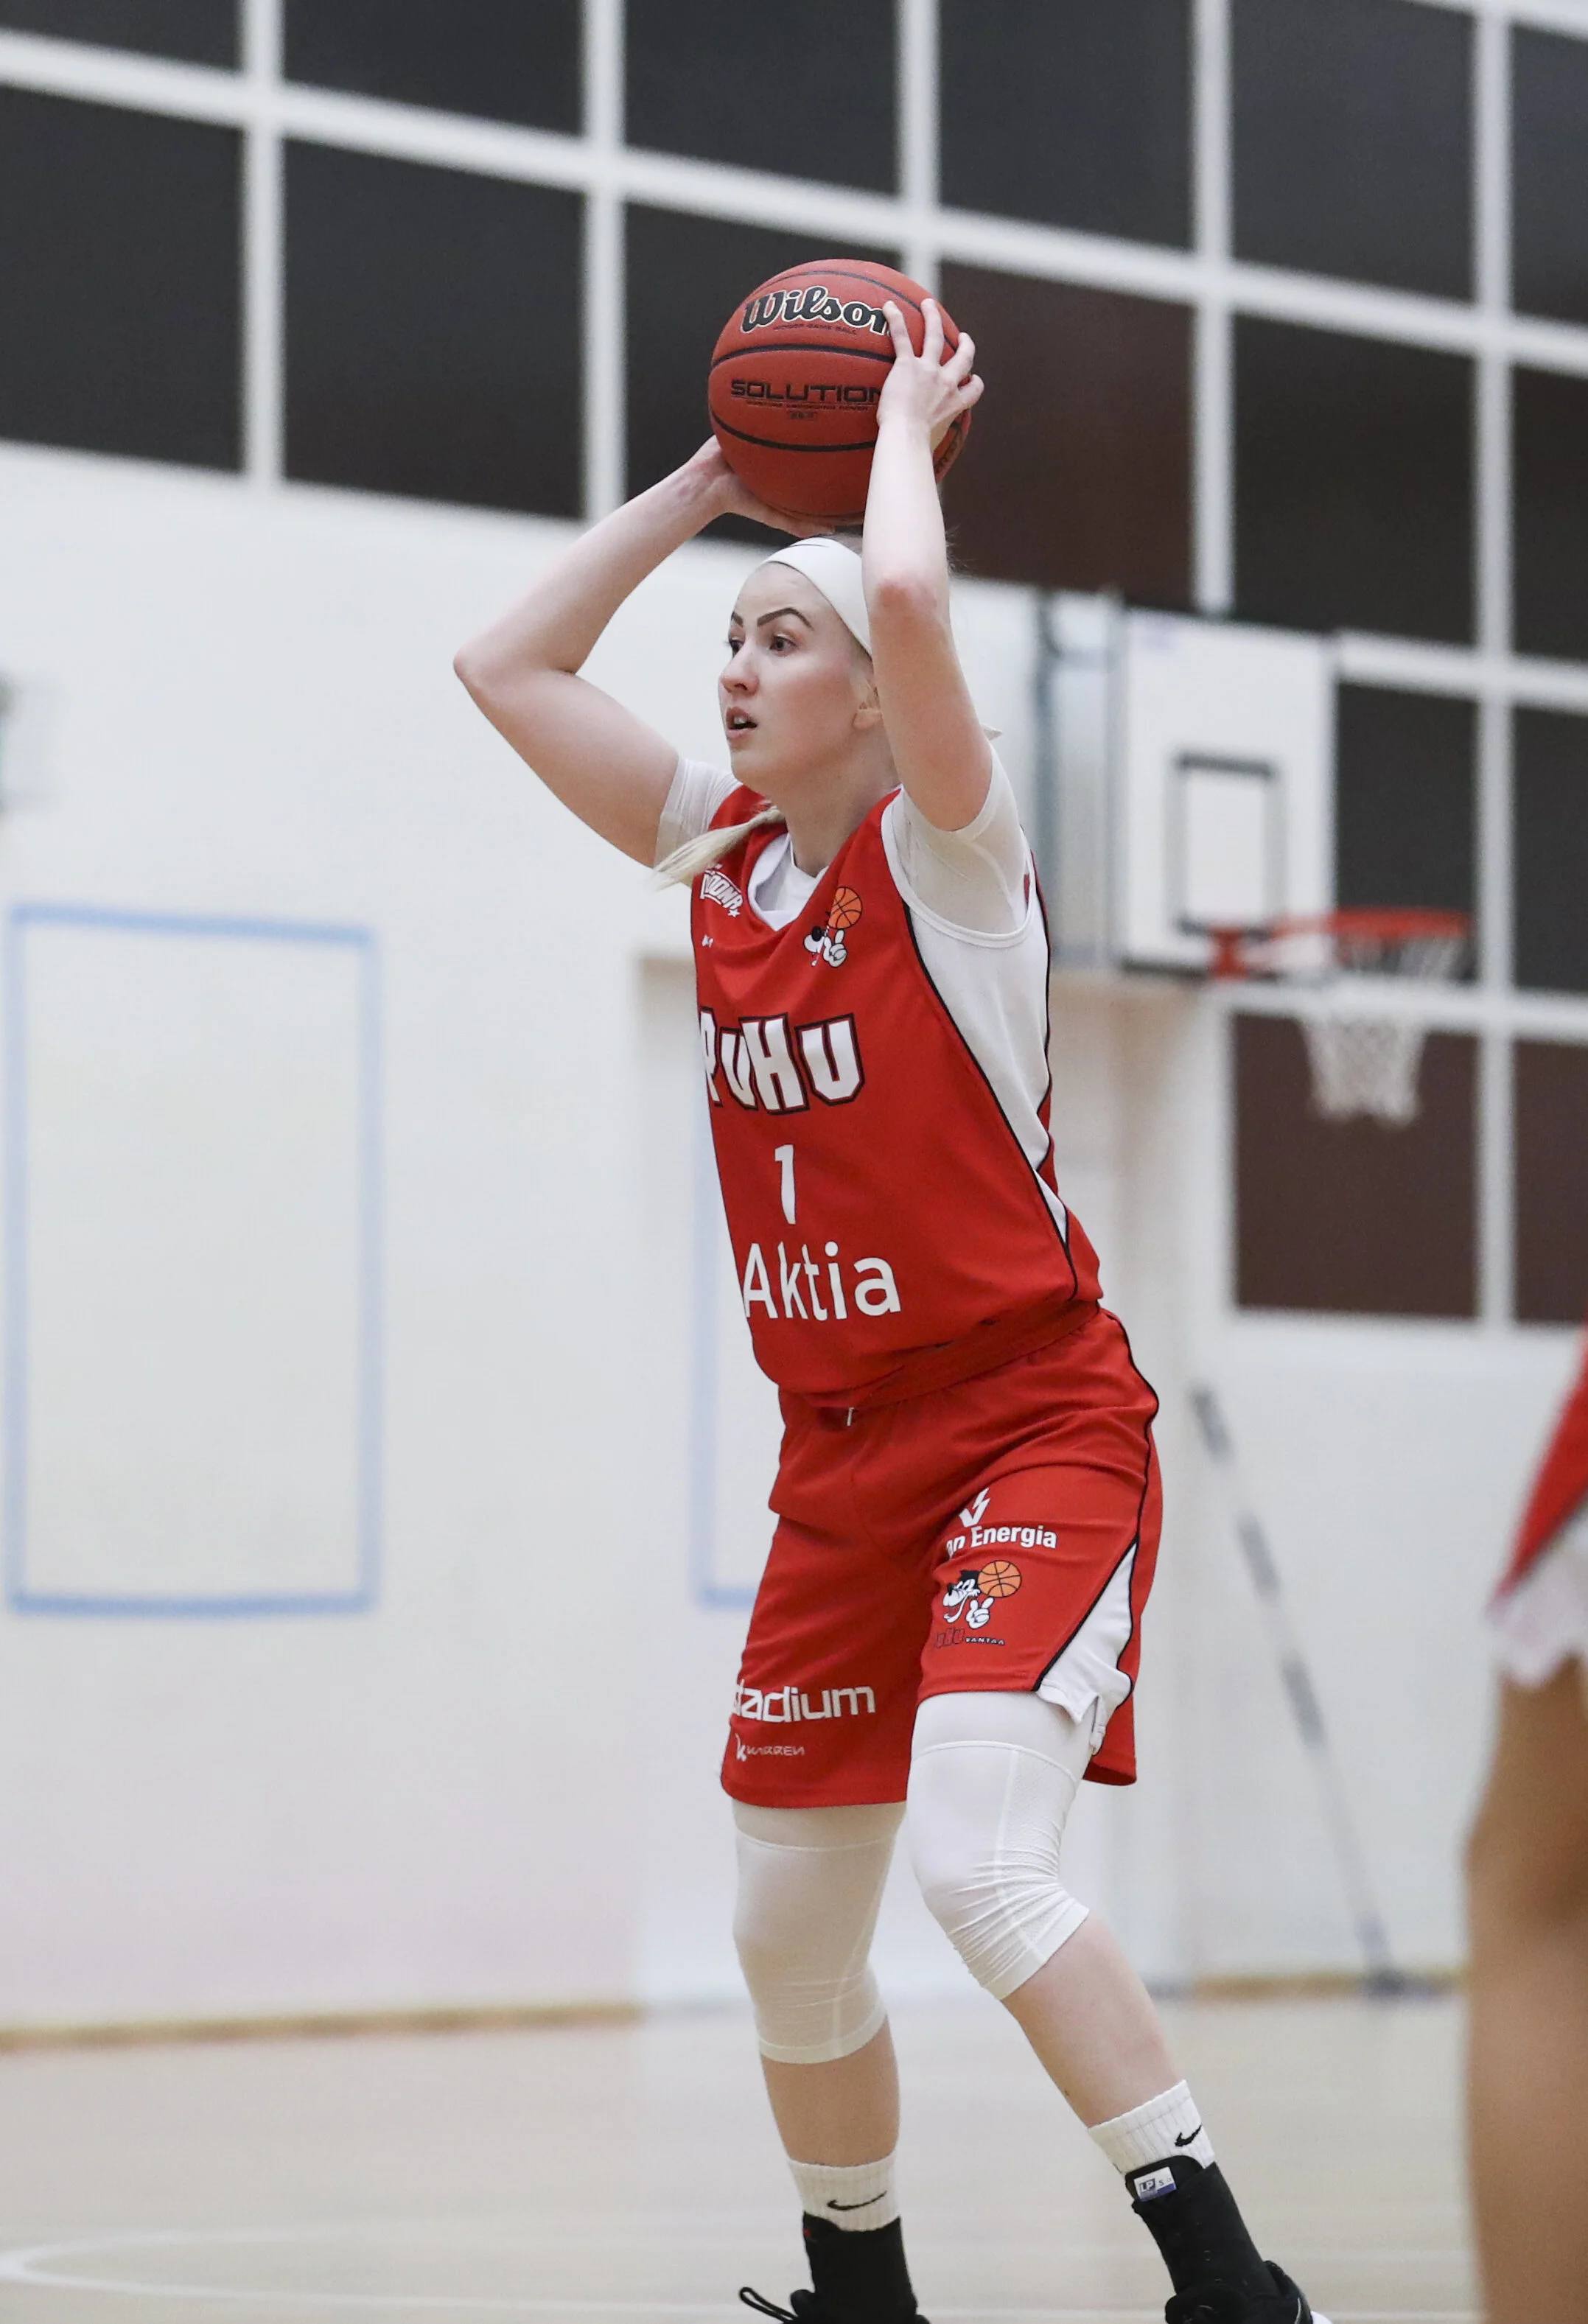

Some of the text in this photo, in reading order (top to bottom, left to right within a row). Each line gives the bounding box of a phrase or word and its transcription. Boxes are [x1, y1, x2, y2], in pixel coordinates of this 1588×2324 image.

[740, 285, 887, 336] Wilson
[774, 1144, 797, 1225] 1
[742, 1241, 902, 1321] Aktia
[970, 1525, 1057, 1549] Energia
[965, 1636, 1006, 1646] VANTAA
[734, 1679, 876, 1723] tadium
